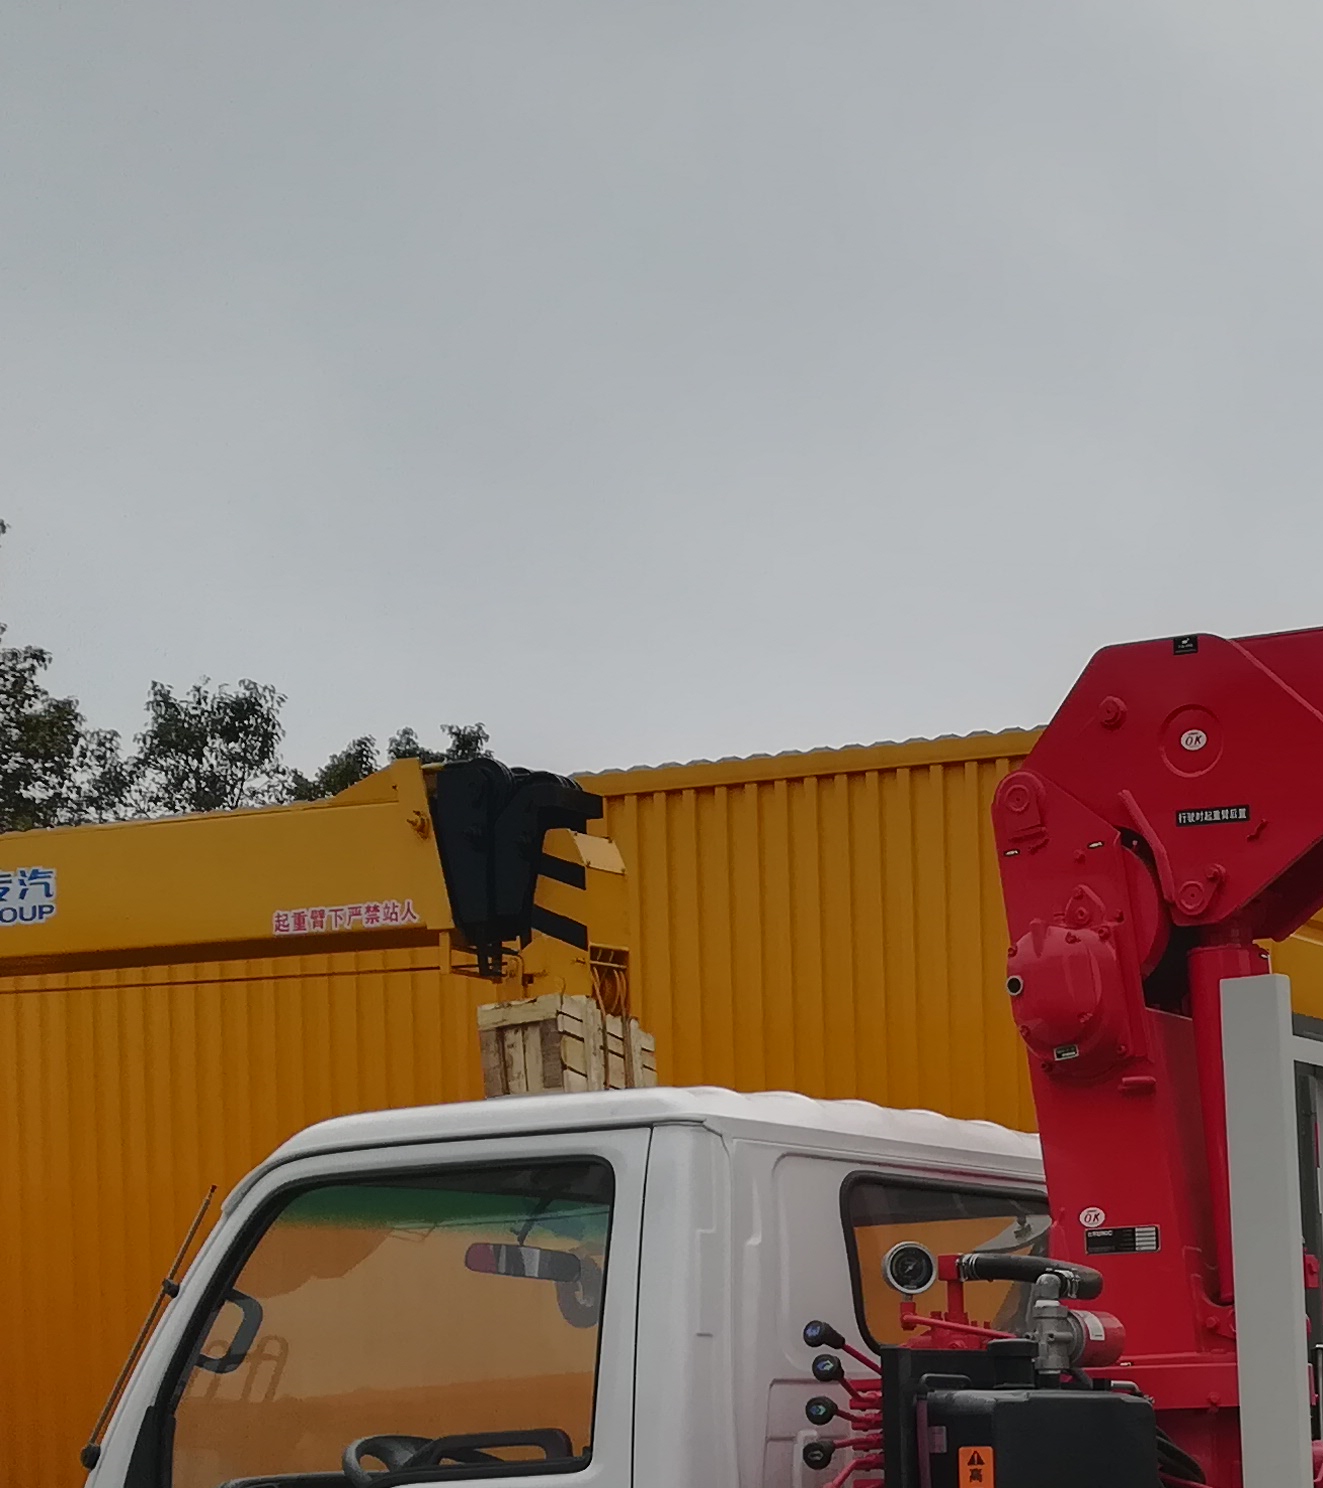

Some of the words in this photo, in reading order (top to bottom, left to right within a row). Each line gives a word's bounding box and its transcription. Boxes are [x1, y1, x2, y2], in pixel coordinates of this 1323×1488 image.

[1185, 734, 1202, 747] OK
[273, 901, 417, 934] 起重臂下严禁站人
[1083, 1212, 1100, 1224] OK
